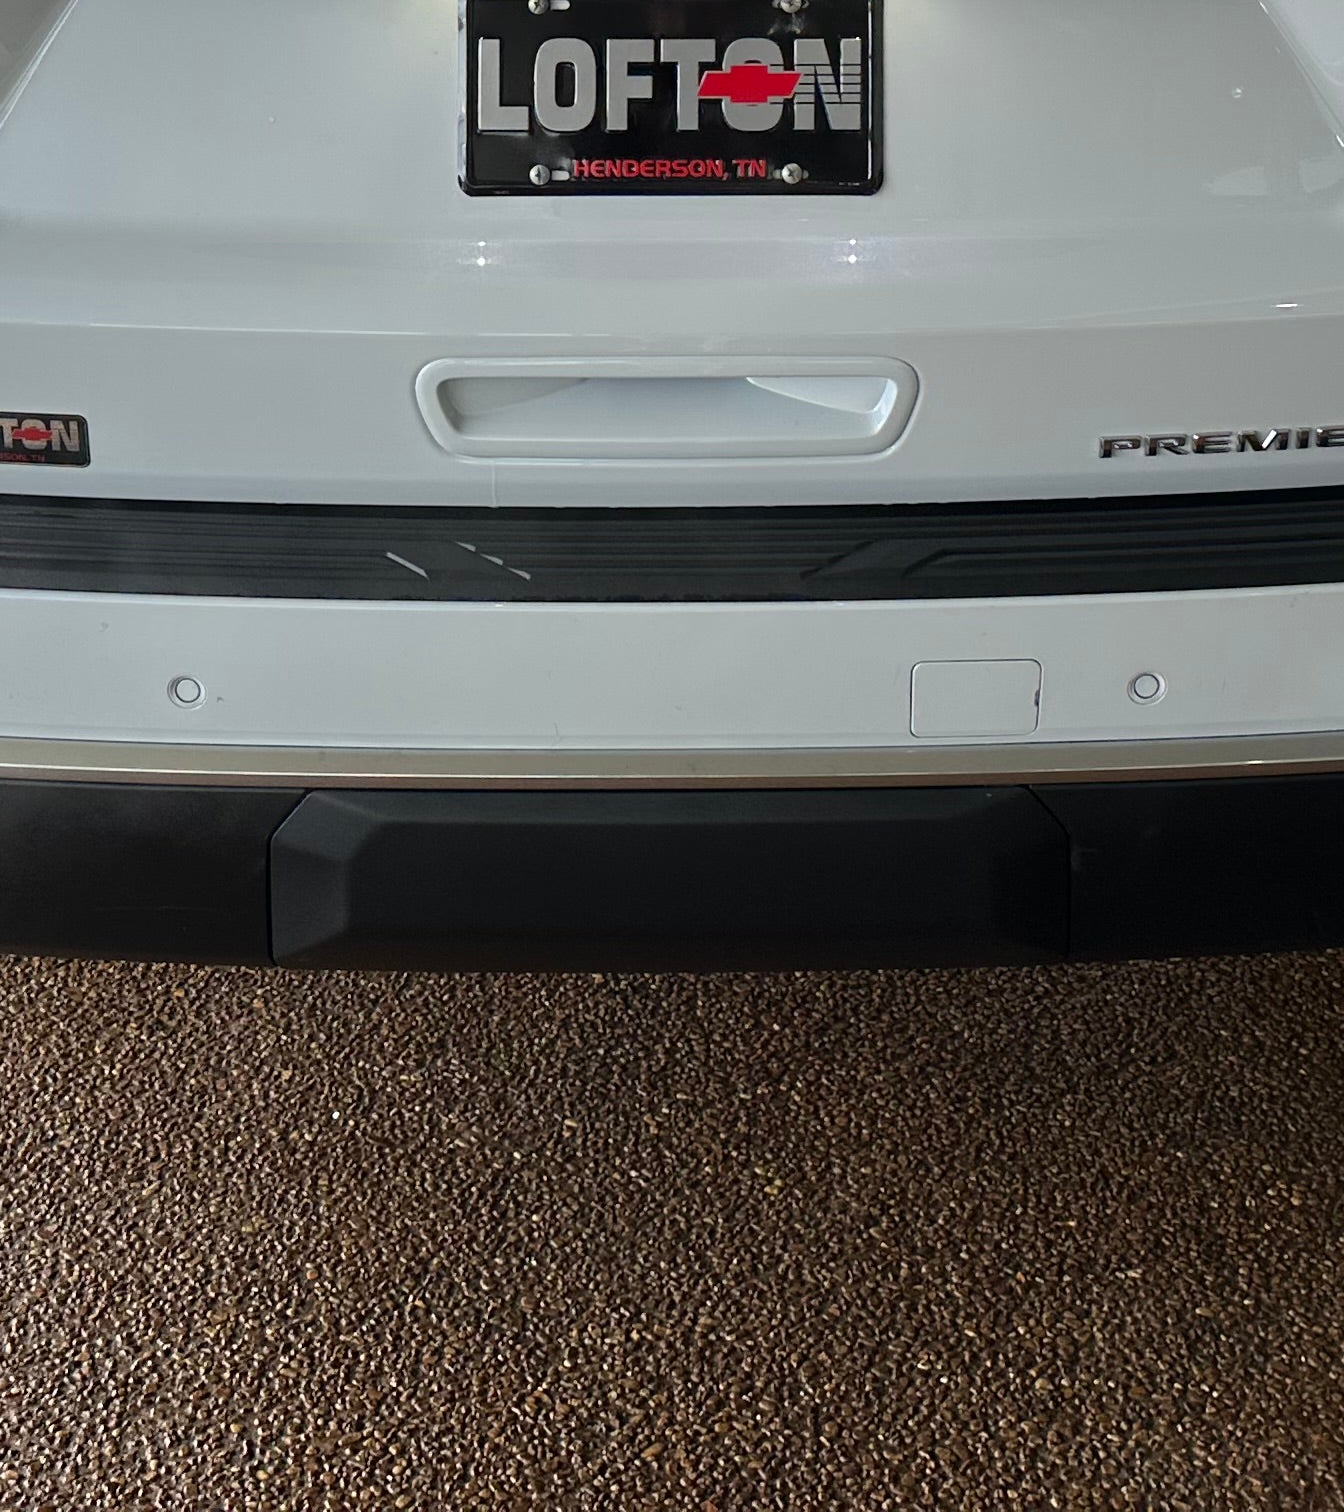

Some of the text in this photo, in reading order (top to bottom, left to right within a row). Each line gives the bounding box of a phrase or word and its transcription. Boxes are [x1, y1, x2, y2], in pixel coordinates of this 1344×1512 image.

[477, 37, 862, 131] LOFTON
[572, 159, 767, 180] HENDERSON, TN
